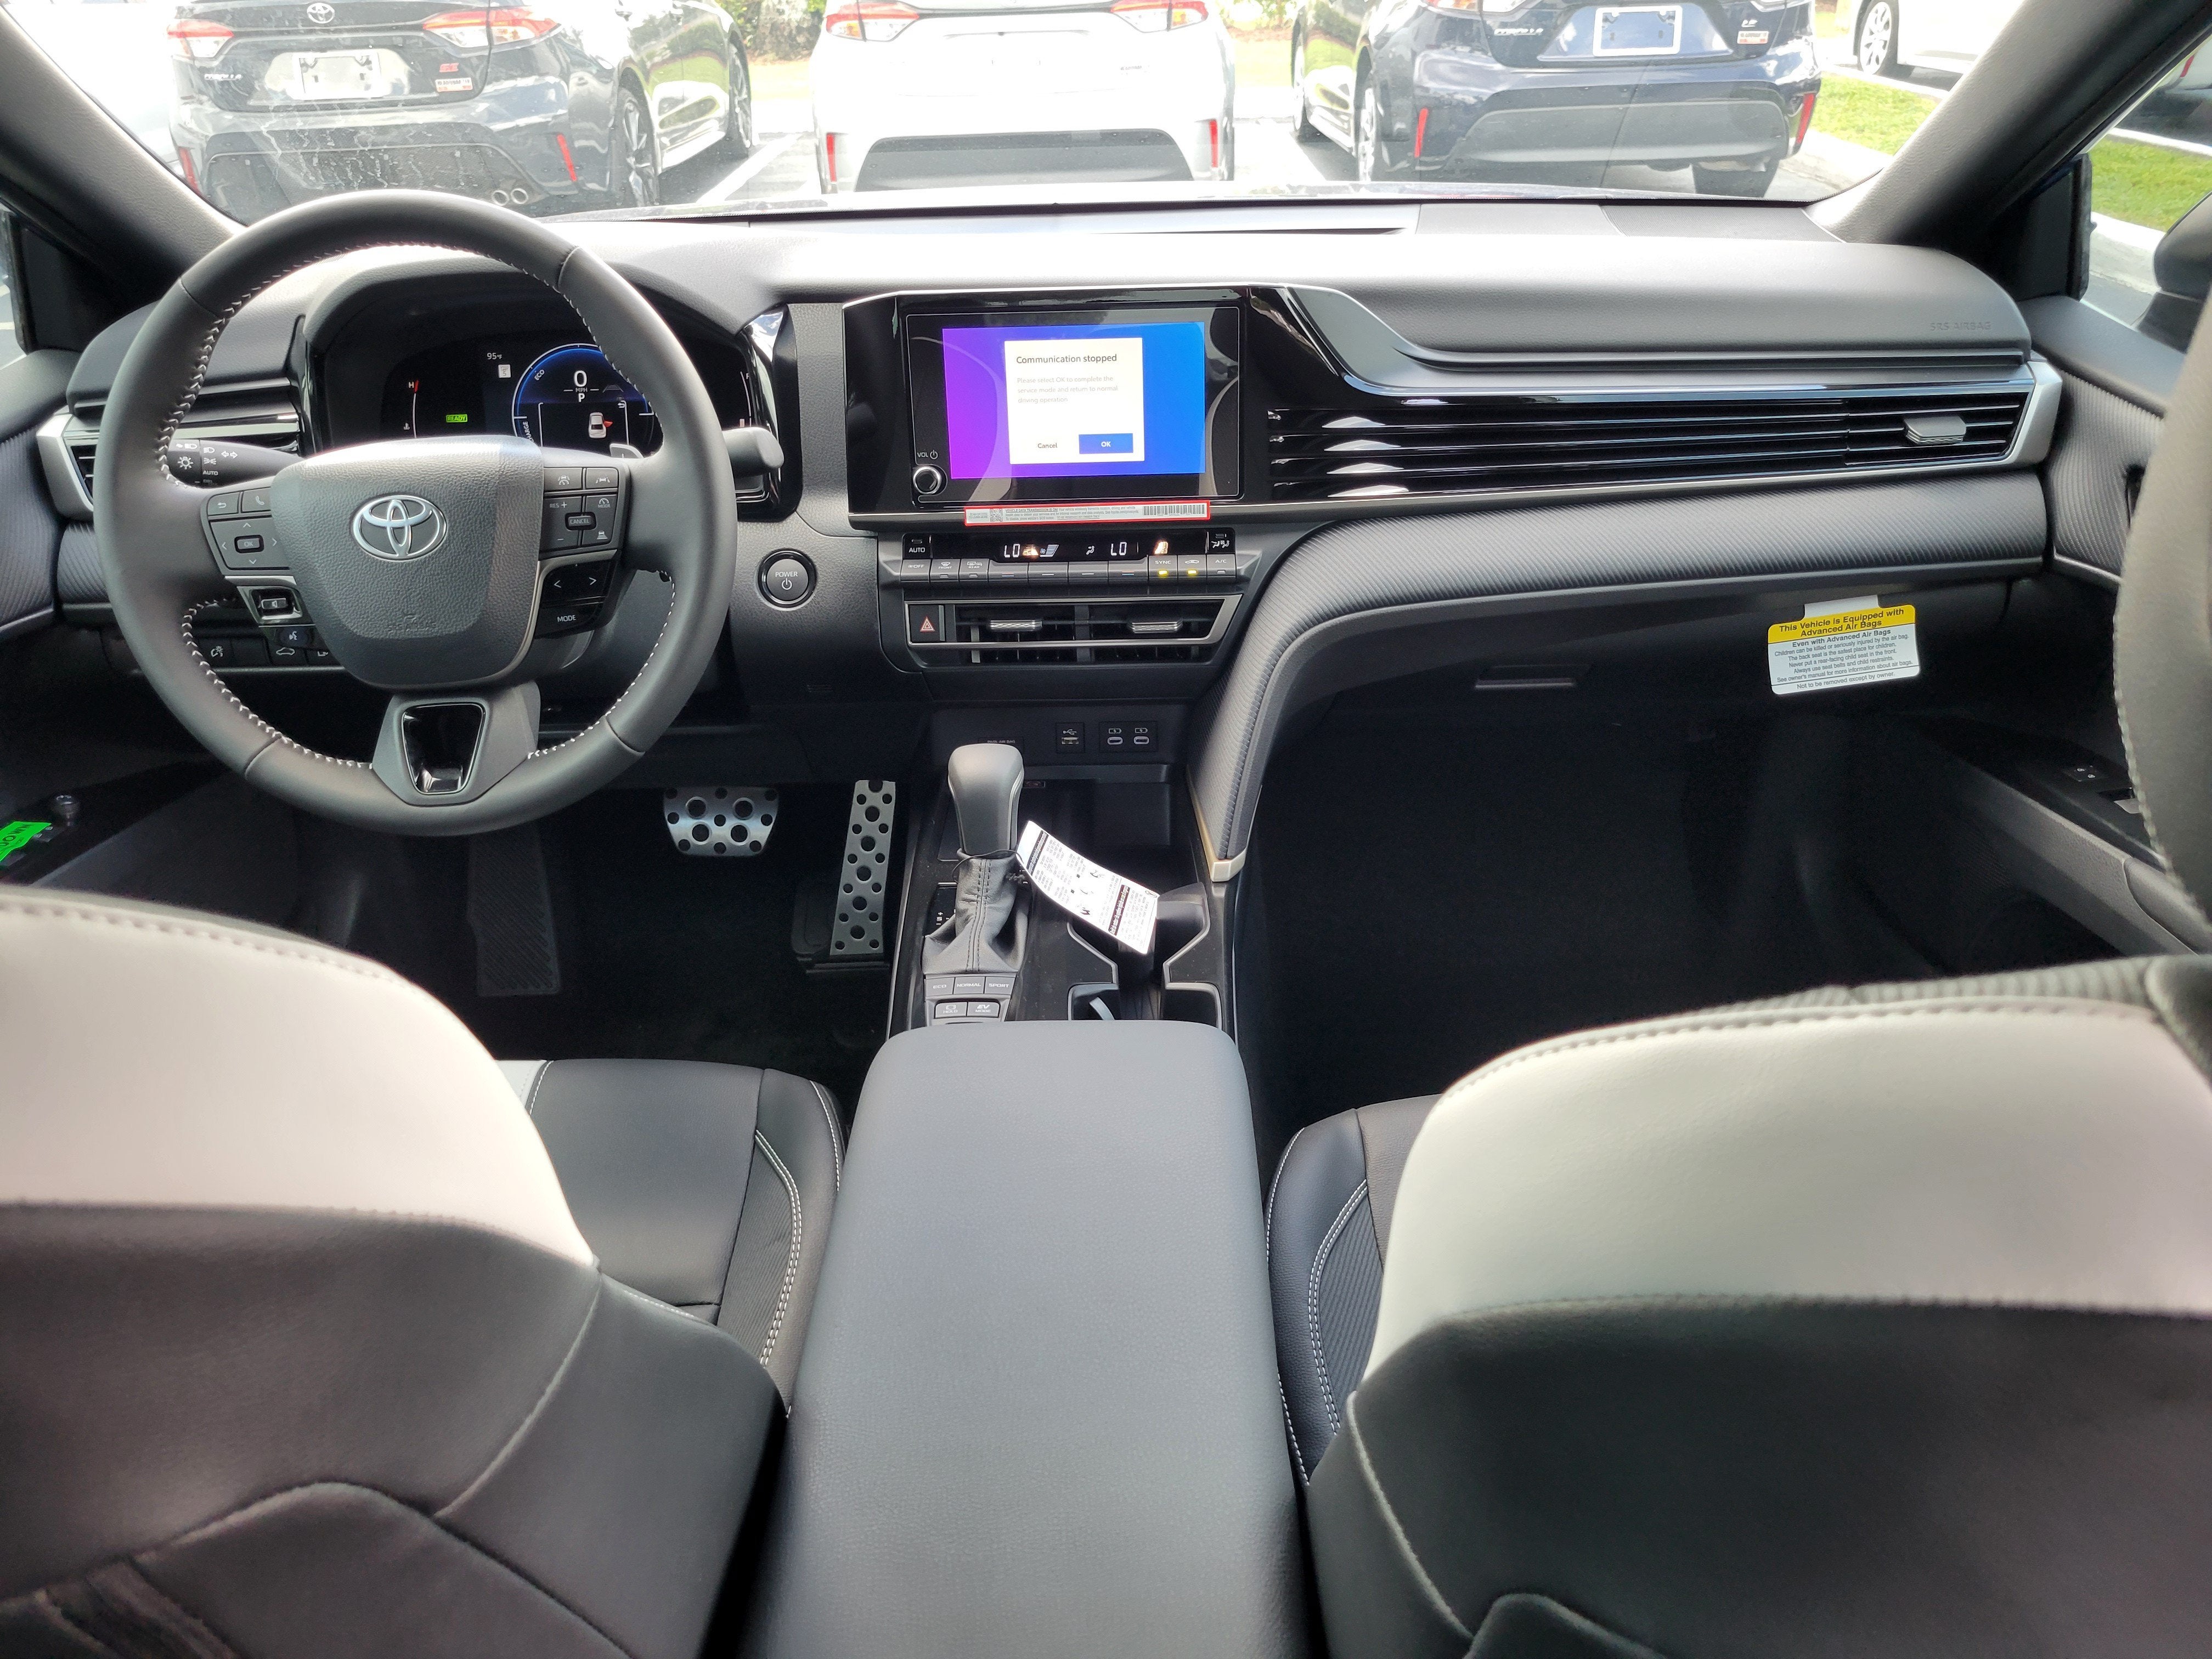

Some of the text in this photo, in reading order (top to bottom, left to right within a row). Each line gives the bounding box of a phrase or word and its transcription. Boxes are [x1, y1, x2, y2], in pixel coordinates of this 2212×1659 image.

[1016, 354, 1117, 364] Communication stopped
[534, 369, 545, 381] ECO
[574, 370, 587, 387] 0
[578, 393, 585, 402] P
[1800, 619, 1830, 629] Vehicle
[1843, 611, 1883, 622] Equipped
[1801, 625, 1843, 636] Advanced
[1846, 622, 1858, 630] Air
[1826, 633, 1860, 642] Advanced
[1818, 656, 1844, 664] rear-facing
